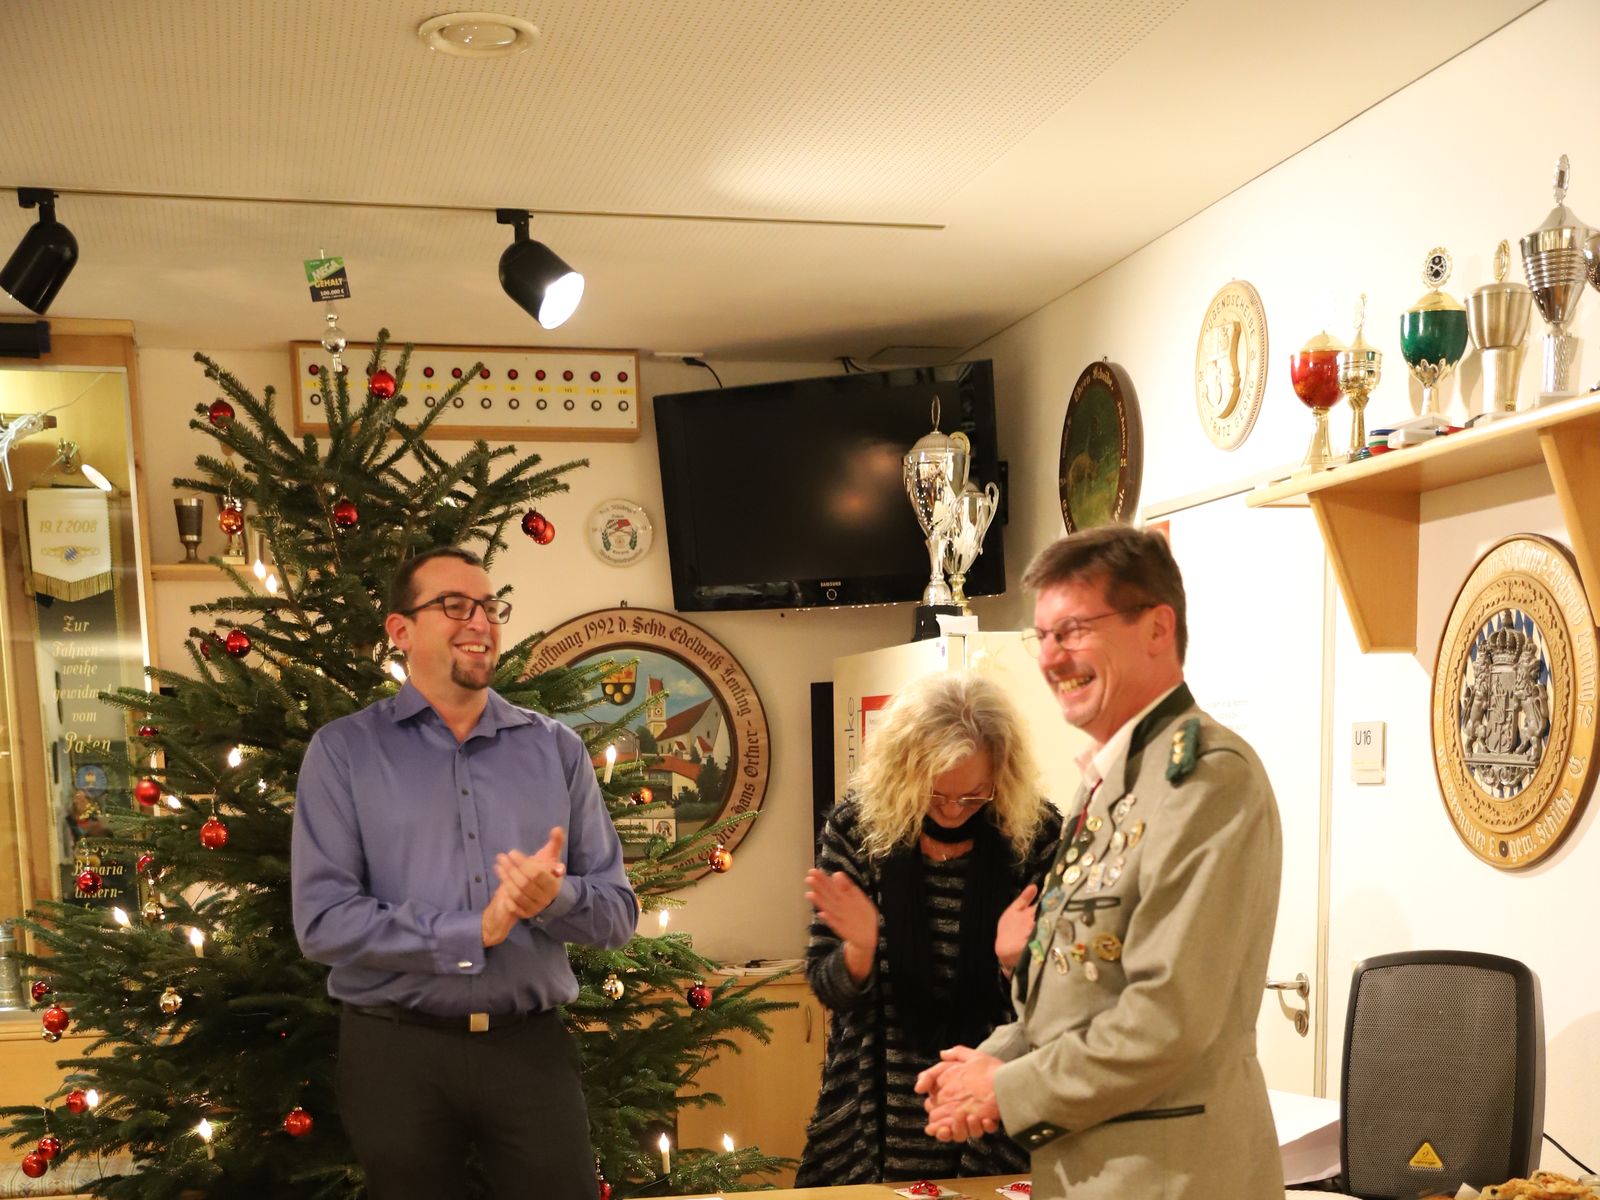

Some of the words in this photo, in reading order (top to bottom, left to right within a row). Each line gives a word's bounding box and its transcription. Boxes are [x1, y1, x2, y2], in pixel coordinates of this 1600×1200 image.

[584, 617, 615, 641] 1992
[52, 683, 112, 703] gewidmt
[743, 730, 760, 778] Ortner
